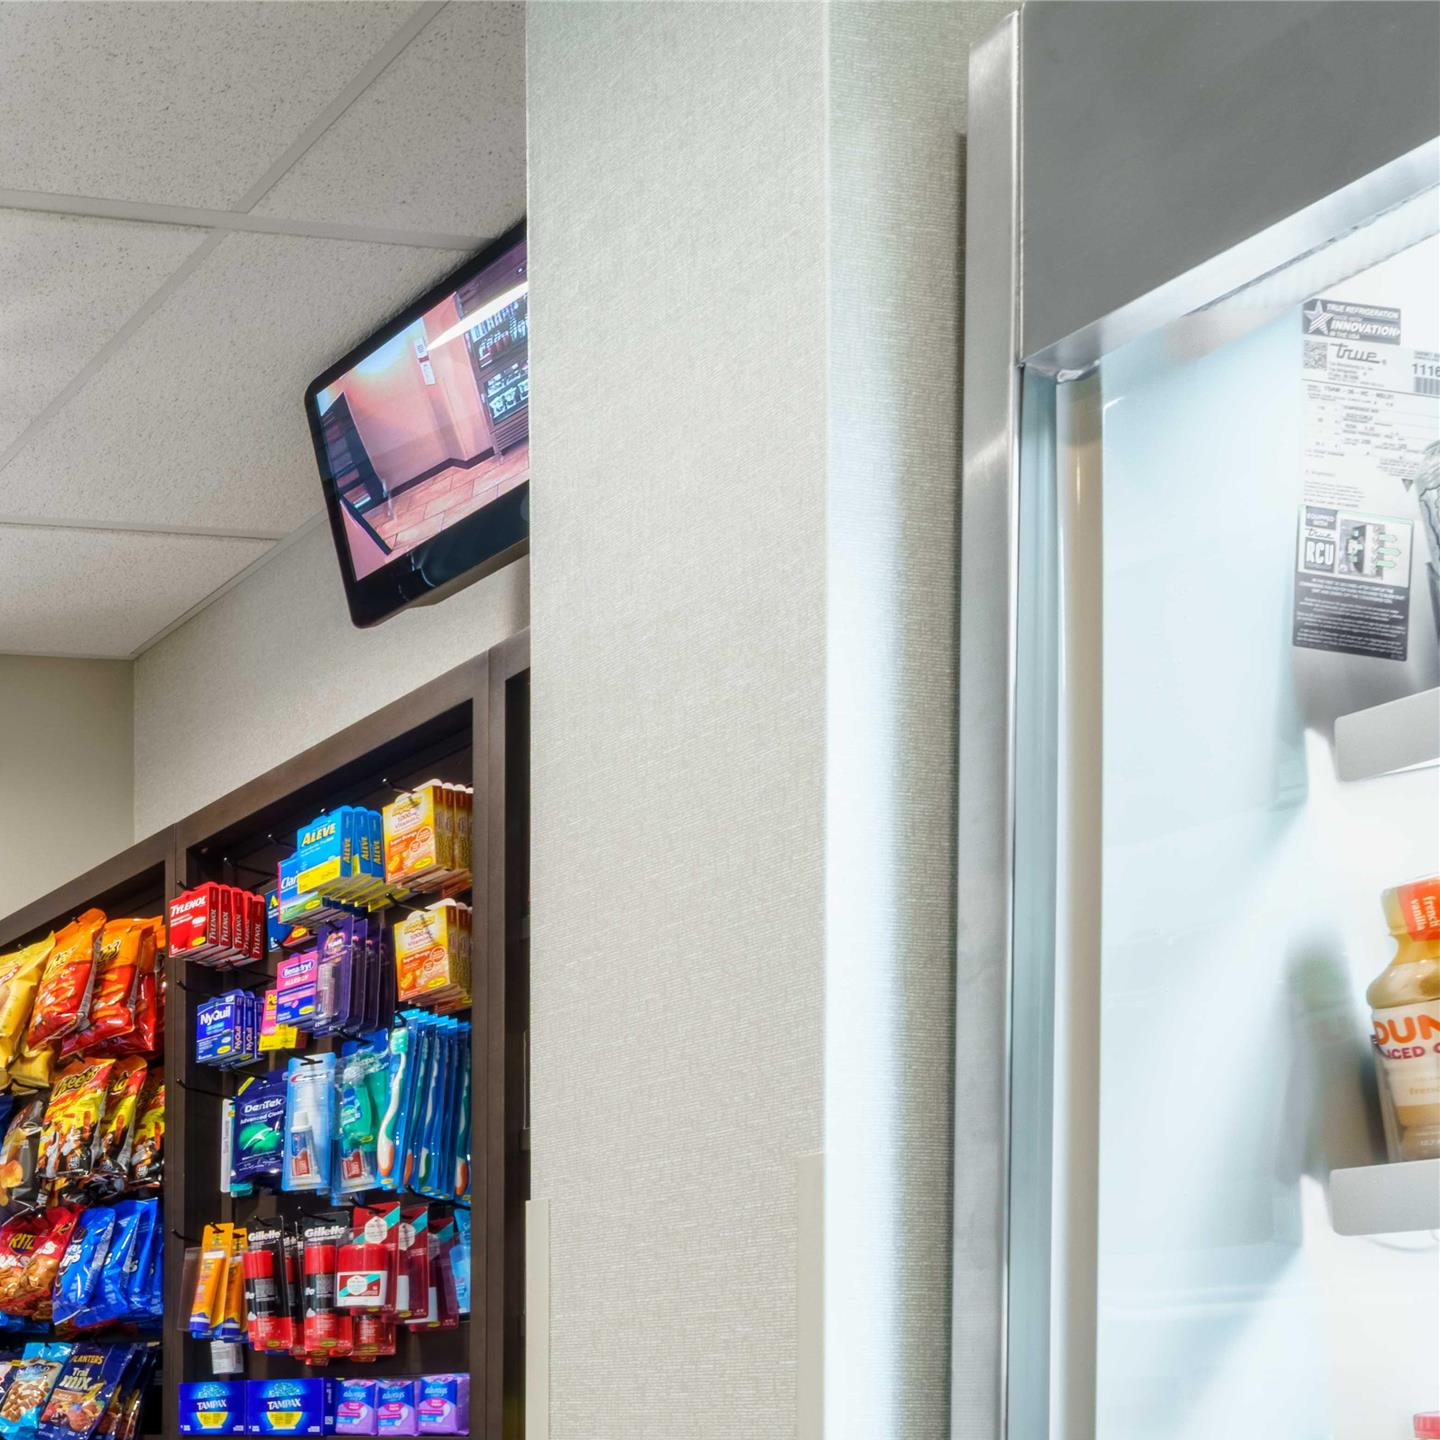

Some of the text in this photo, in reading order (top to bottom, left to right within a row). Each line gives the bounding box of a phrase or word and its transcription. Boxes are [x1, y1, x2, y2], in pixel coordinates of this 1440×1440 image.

[1331, 320, 1397, 337] INNOVATION
[1306, 541, 1334, 565] RCU
[302, 823, 336, 847] ALEVE
[170, 896, 207, 917] TYLENOL
[1410, 899, 1425, 931] vanilla
[200, 1006, 231, 1026] NyQuil
[234, 1026, 242, 1050] NyQuil
[246, 1027, 254, 1051] NyQuil
[244, 1098, 282, 1113] DenTek
[248, 1230, 281, 1242] Gillette
[305, 1226, 345, 1238] Gillette
[71, 1355, 104, 1365] PLANTERS
[197, 1399, 227, 1411] TAMPAX
[267, 1398, 302, 1410] TAMPAX
